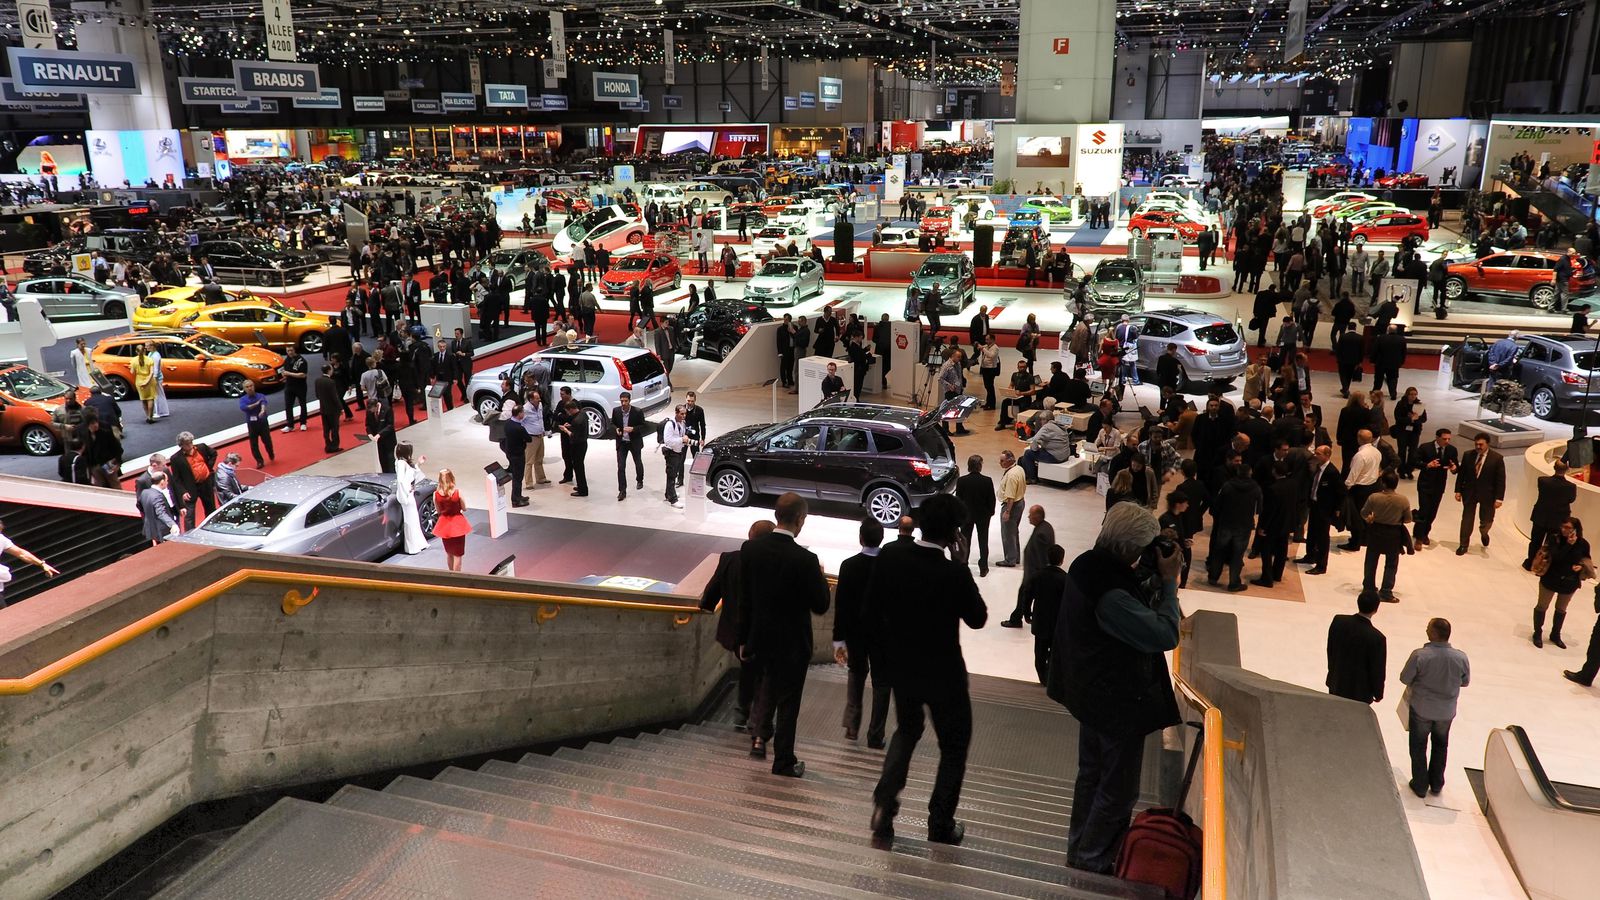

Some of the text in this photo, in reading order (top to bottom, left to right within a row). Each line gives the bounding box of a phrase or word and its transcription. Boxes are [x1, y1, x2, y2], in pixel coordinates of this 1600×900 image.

[273, 7, 281, 21] 4
[268, 25, 293, 37] ALLEE
[271, 40, 292, 52] 4200
[1058, 39, 1067, 51] F
[32, 62, 122, 82] RENAULT
[252, 72, 305, 87] BRABUS
[604, 82, 631, 95] HONDA
[498, 91, 516, 102] TATA
[728, 134, 760, 143] Ferrari
[1515, 129, 1545, 140] ZERO
